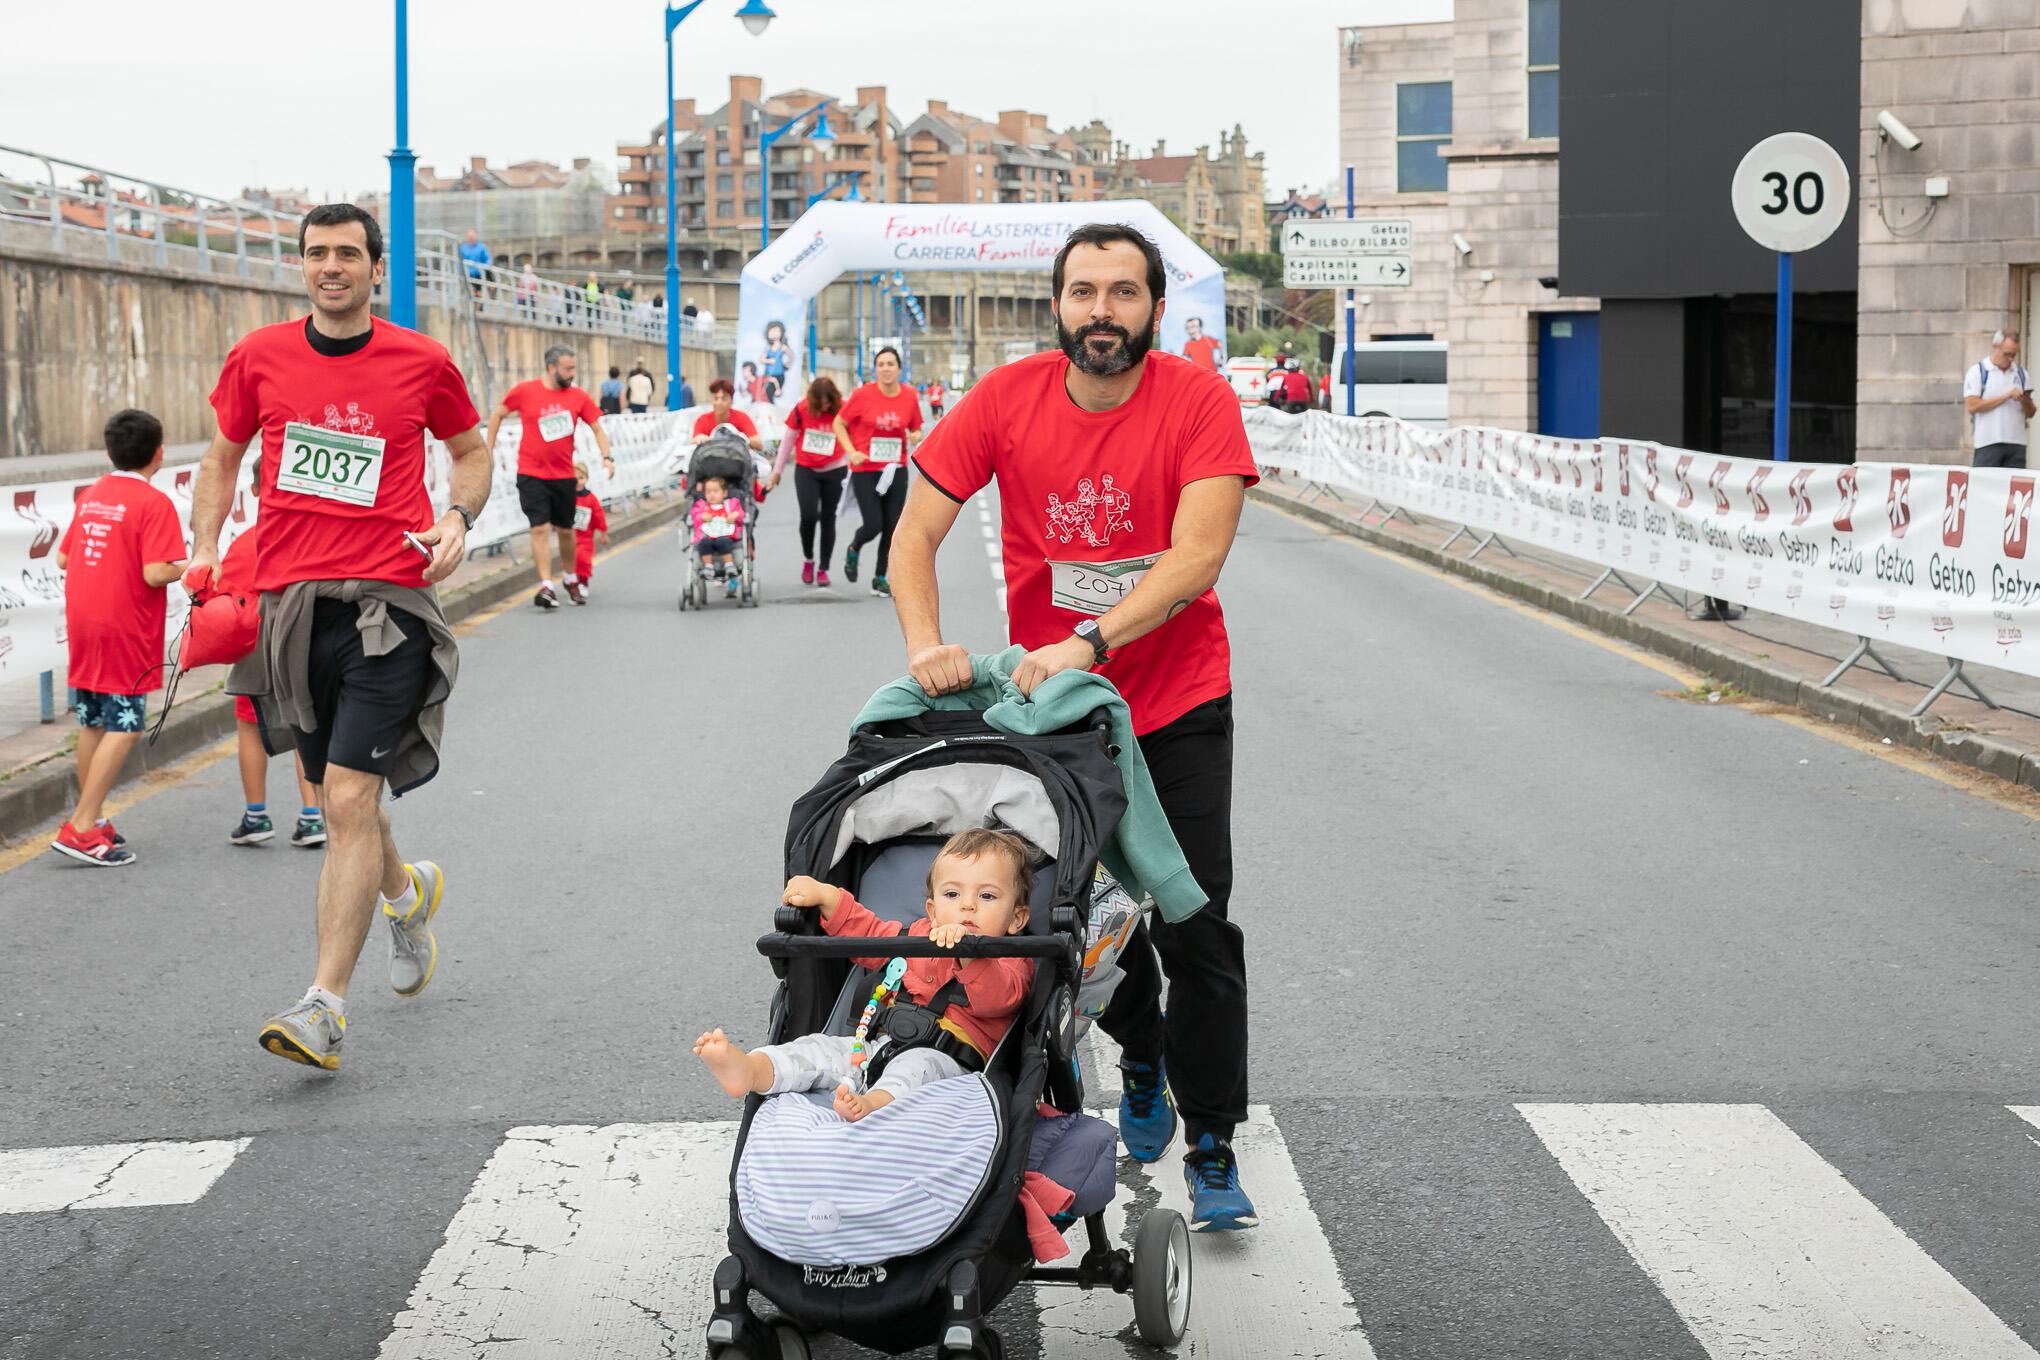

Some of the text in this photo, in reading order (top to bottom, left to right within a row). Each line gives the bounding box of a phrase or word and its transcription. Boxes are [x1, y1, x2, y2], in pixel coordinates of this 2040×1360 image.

[1761, 171, 1824, 215] 30
[291, 444, 373, 487] 2037
[1779, 531, 1819, 566] Getxo
[1829, 536, 1863, 577] Getxo
[1876, 544, 1914, 586] Getxo
[1929, 552, 1976, 597] Getxo
